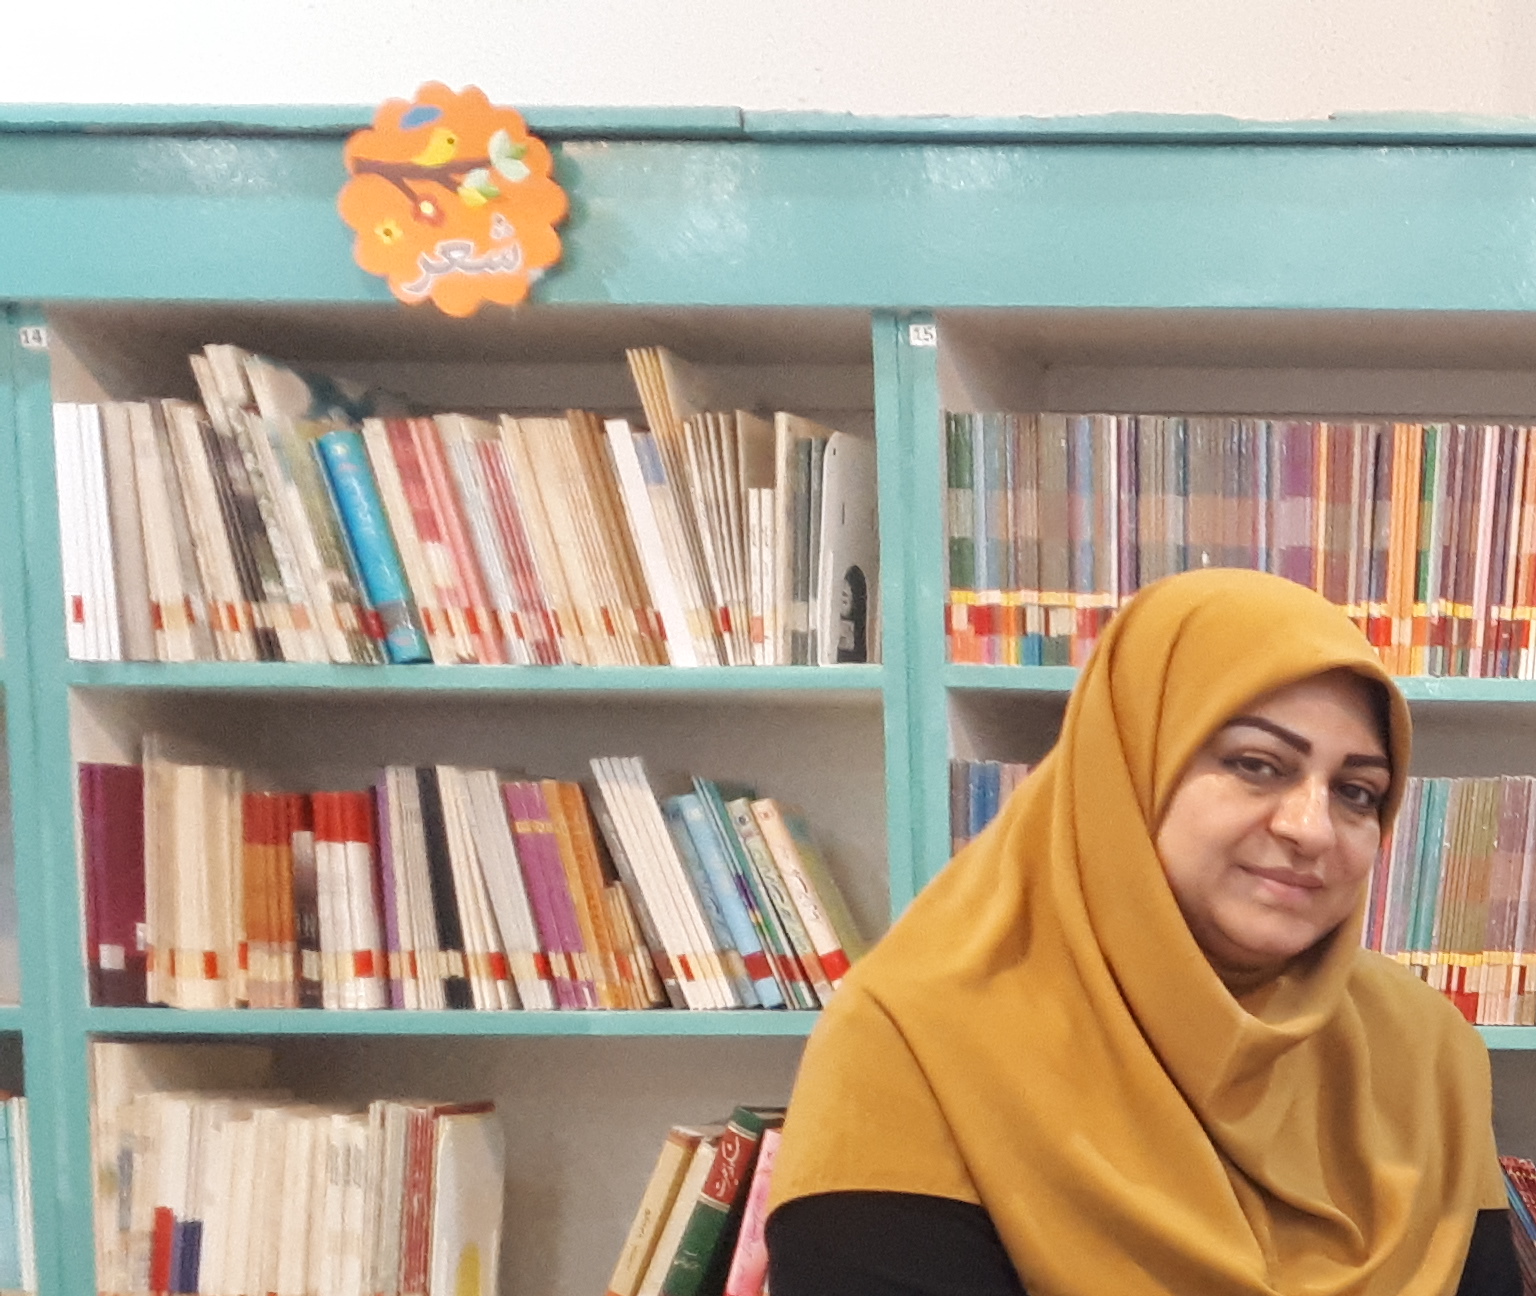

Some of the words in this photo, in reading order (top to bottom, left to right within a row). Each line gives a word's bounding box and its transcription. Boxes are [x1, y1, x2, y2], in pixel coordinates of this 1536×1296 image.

[400, 211, 522, 294] شعر
[22, 329, 43, 344] 14
[914, 327, 934, 342] 15
